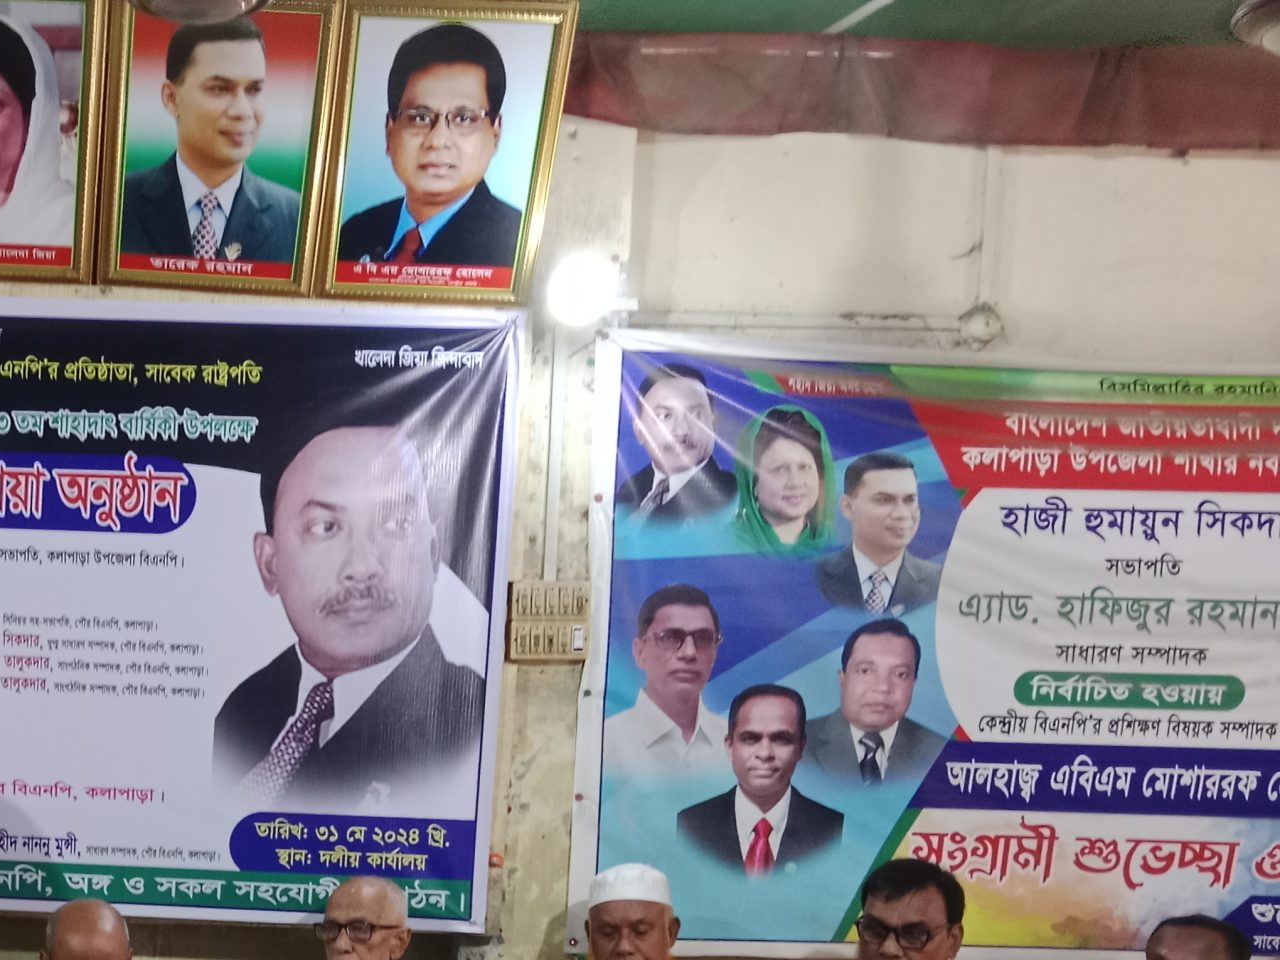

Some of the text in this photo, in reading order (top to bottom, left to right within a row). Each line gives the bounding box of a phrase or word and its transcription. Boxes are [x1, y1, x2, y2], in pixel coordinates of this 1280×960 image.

[64, 355, 139, 387] প্রতিষ্ঠাতা,
[145, 362, 197, 384] সাবেক
[202, 359, 263, 387] রাষ্ট্রপতি
[354, 348, 397, 368] খালেদা
[399, 344, 429, 369] জিয়া
[181, 407, 259, 443] উপলক্ষে
[1004, 411, 1109, 438] বাংলাদেশ
[1118, 410, 1261, 441] জাতীয়তাবাদী
[961, 442, 1237, 477] কলাপাড়া উপজেলা শাখার
[51, 449, 190, 533] অনুষ্ঠান
[1000, 496, 1183, 546] হাজী হুমায়ুন
[0, 546, 43, 566] সভাপতি,
[94, 548, 135, 568] উপজেলা
[1105, 552, 1183, 579] সভাপতি
[1056, 585, 1176, 635] হাফিজুর
[1186, 596, 1280, 633] রহমান
[1056, 642, 1210, 667] সাধারণ সম্পাদক
[1029, 673, 1228, 707] নির্বাচিত হওয়ায়
[977, 708, 1028, 735] কেন্দ্রীয়
[1108, 712, 1162, 737] প্রশিক্ষণ
[1167, 714, 1215, 739] বিষয়ক
[1220, 719, 1279, 741] সম্পাদক
[13, 780, 77, 802] বিএনপি,
[945, 757, 1043, 804] আলহাজ্ব
[1050, 753, 1137, 800] এবিএম
[1143, 763, 1262, 802] মোশাররফ
[315, 825, 339, 843] ৩১
[346, 825, 368, 844] মে
[372, 826, 421, 848] ২০২৪
[318, 844, 429, 872] দলীয় কার্যালয়
[910, 815, 1242, 891] সংগ্রামী শুভেচ্ছা
[63, 871, 115, 895] অঙ্গ
[123, 876, 146, 895] ও
[154, 876, 225, 899] সকল
